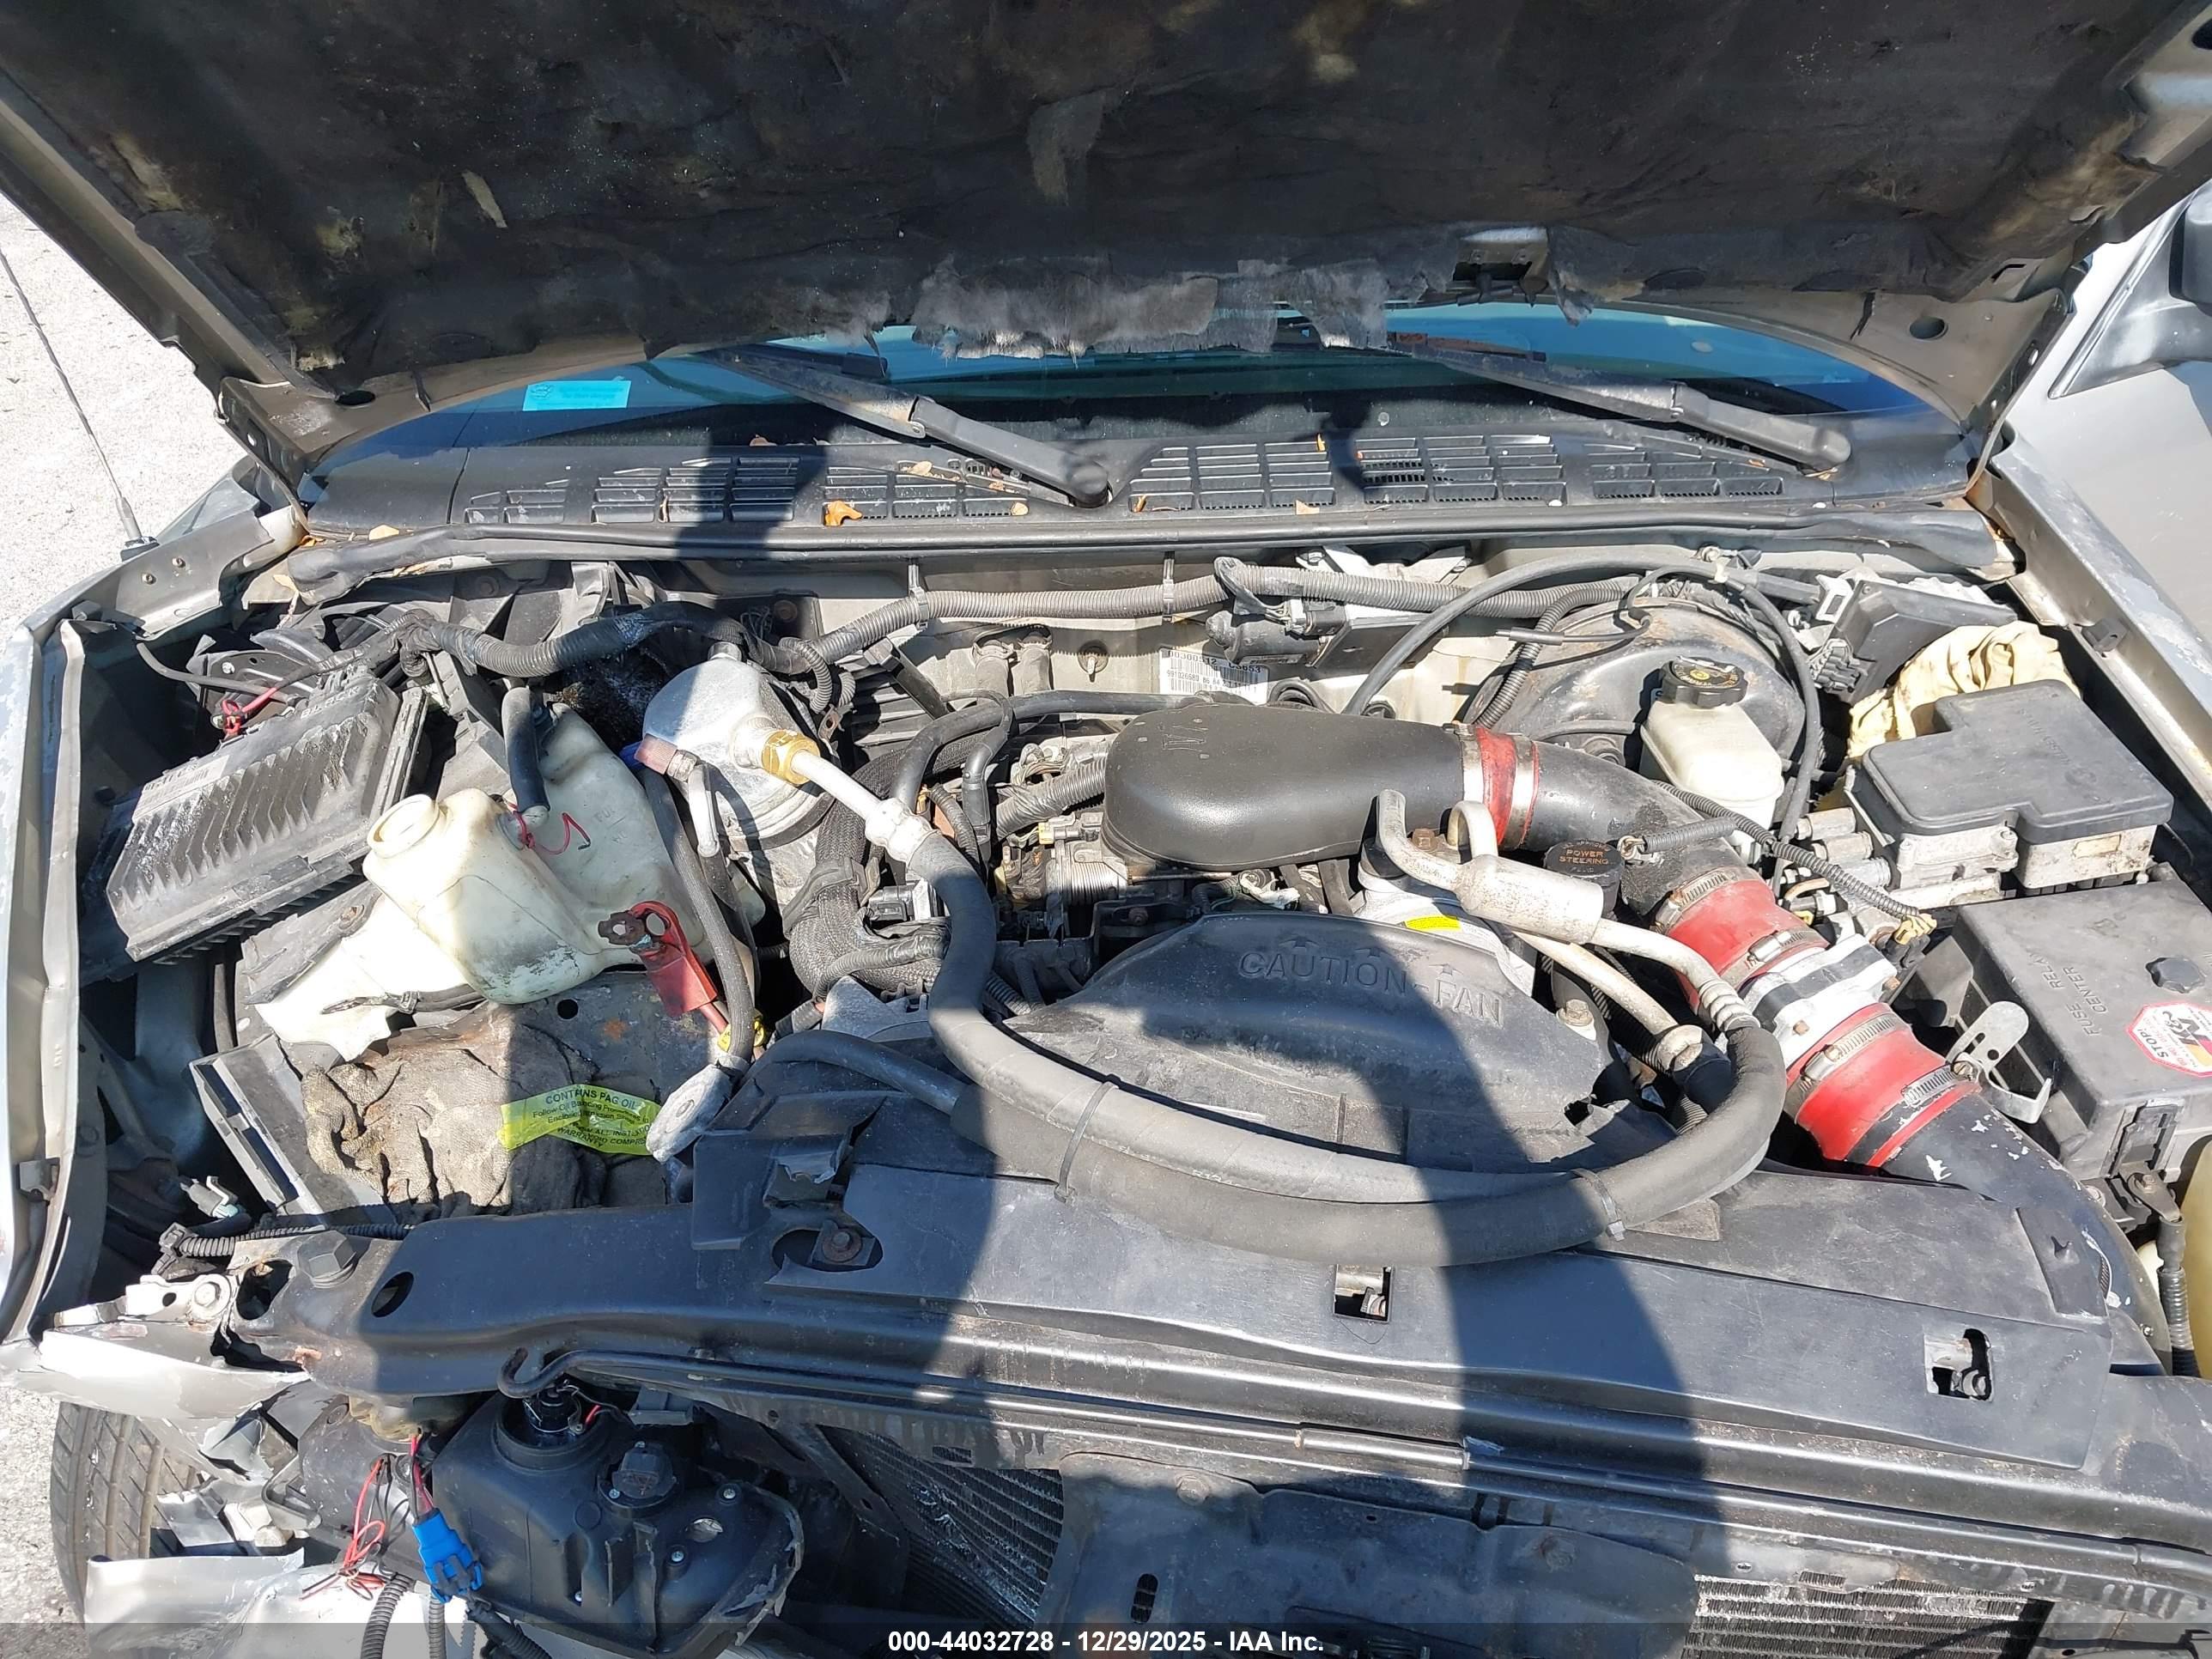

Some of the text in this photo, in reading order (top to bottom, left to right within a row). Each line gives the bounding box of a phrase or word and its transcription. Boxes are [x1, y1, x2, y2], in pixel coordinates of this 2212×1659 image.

[1559, 855, 1609, 866] STEERING
[1565, 849, 1604, 858] POWER
[2029, 951, 2100, 1036] FUSE RELAY
[2062, 966, 2109, 1015] CENTER
[2136, 1028, 2169, 1058] STOP!
[545, 1088, 637, 1109] CONTAINS PAG OIL
[532, 1106, 557, 1118] Follow
[557, 1127, 606, 1147] WARRANTY
